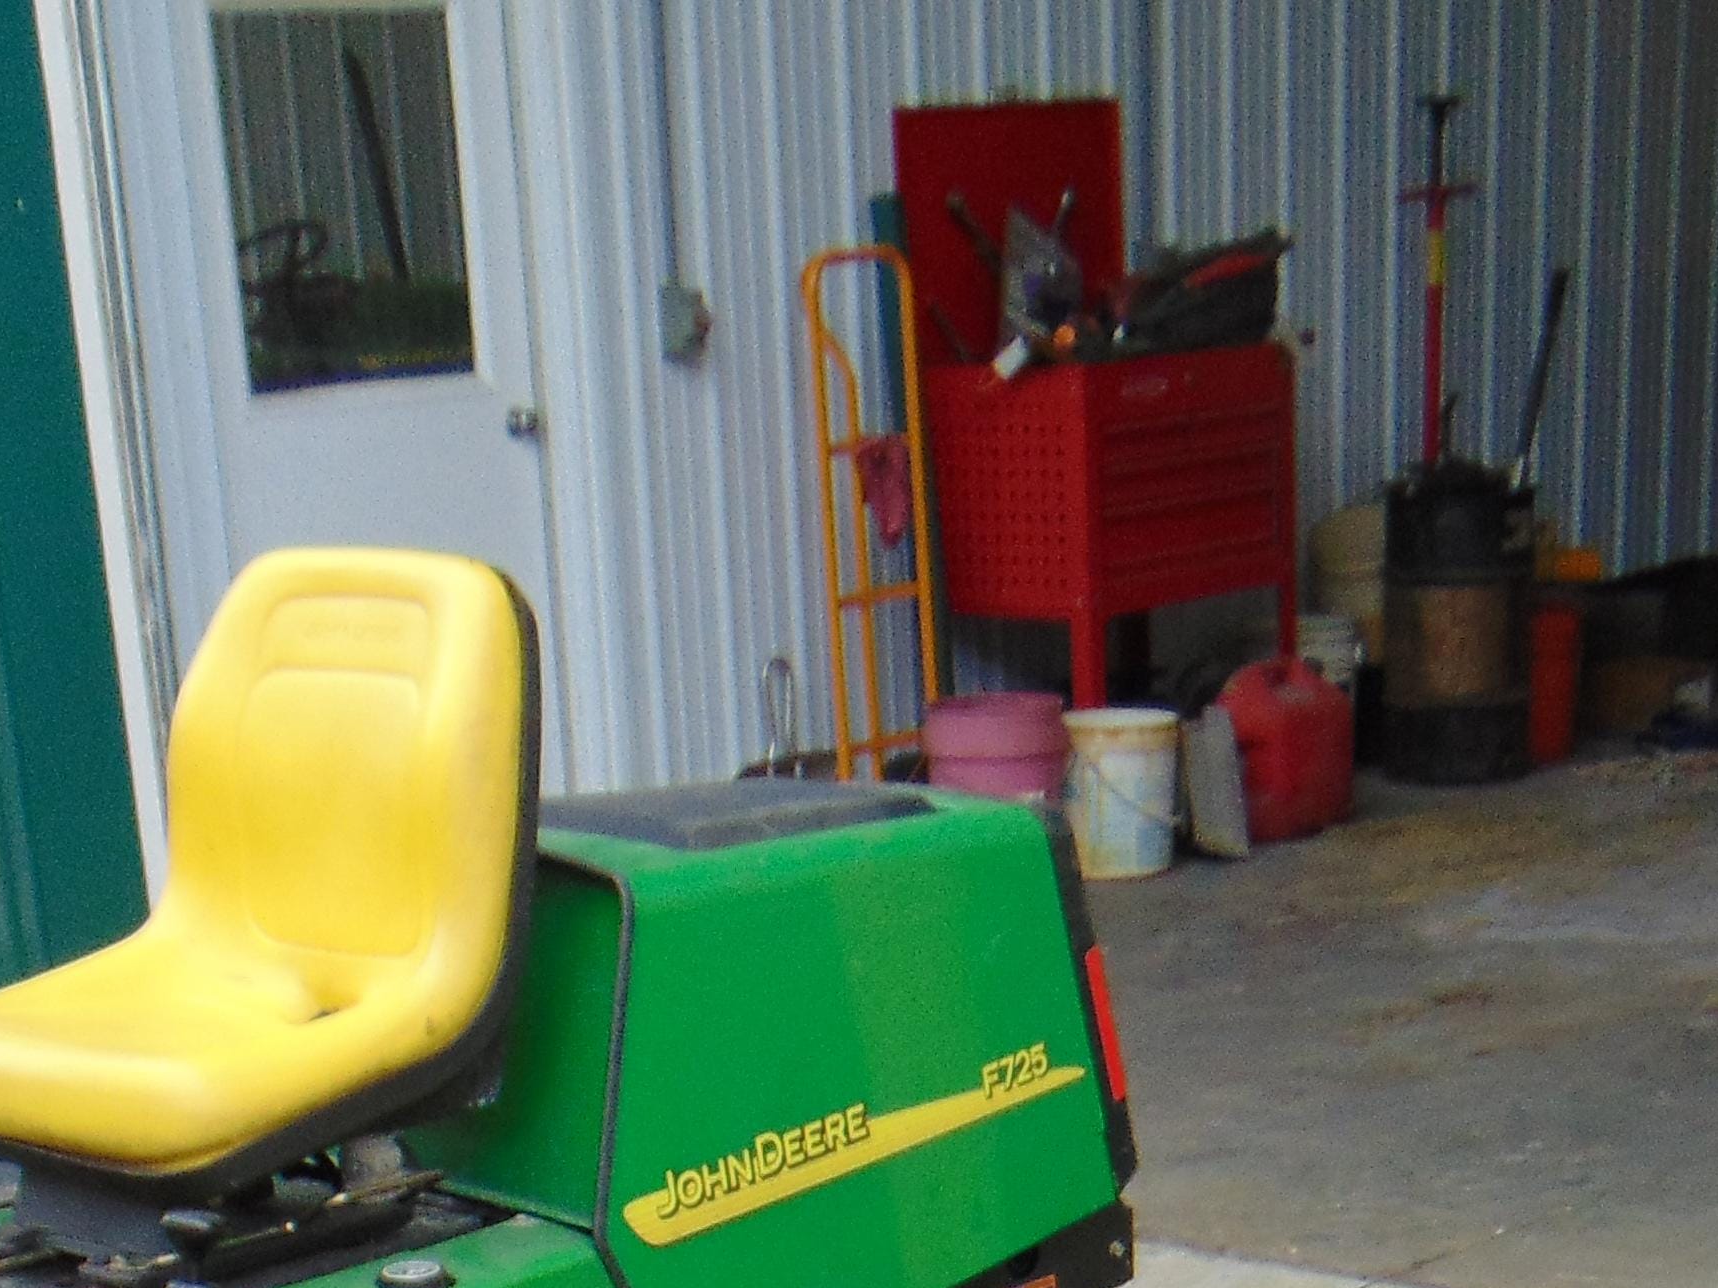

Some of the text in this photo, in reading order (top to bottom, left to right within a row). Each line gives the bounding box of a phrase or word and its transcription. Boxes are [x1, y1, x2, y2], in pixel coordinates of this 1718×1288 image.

[656, 1041, 1049, 1220] JOHN DEERE F725
